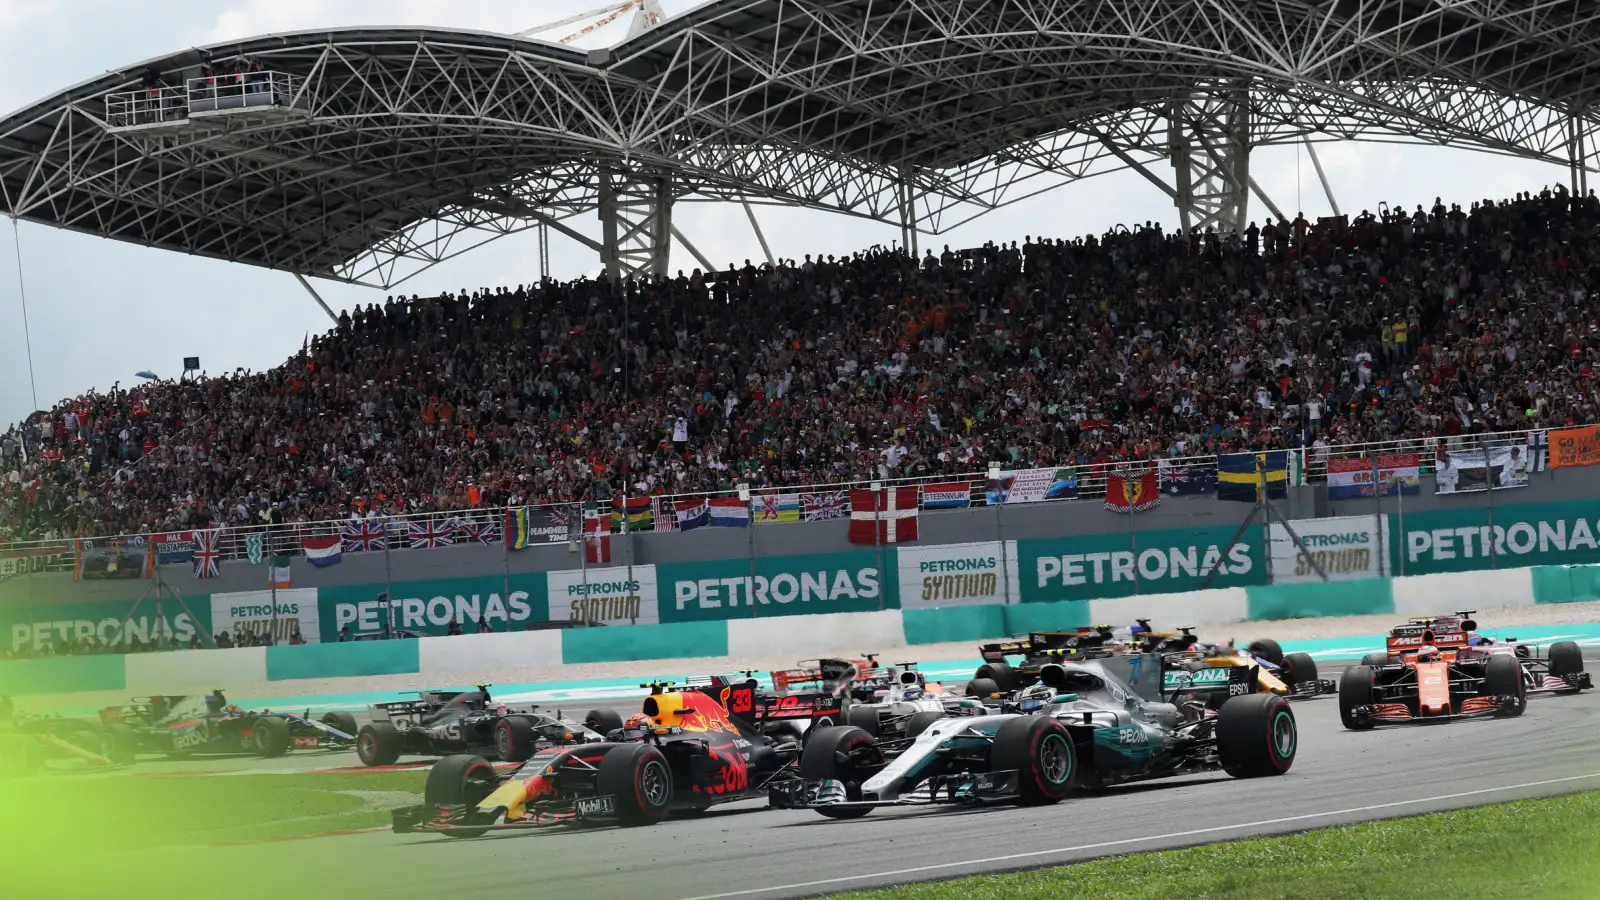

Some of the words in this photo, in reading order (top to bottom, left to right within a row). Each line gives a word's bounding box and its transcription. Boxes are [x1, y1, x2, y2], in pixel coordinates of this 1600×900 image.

[166, 533, 182, 542] MAX
[1293, 532, 1369, 548] ETRONAS
[1408, 518, 1600, 562] PETRONA
[920, 557, 996, 573] PETRONAS
[1037, 543, 1252, 588] PETRONAS
[568, 580, 640, 596] PETRONAS
[675, 567, 880, 610] PETRONAS
[922, 572, 997, 600] SYNTIUM
[231, 603, 299, 617] PETRONAS
[336, 591, 531, 631] PETRONAS
[12, 612, 196, 651] PETRONAS
[1230, 683, 1249, 696] EPSON
[733, 689, 752, 713] 33
[578, 799, 600, 815] Mobil
